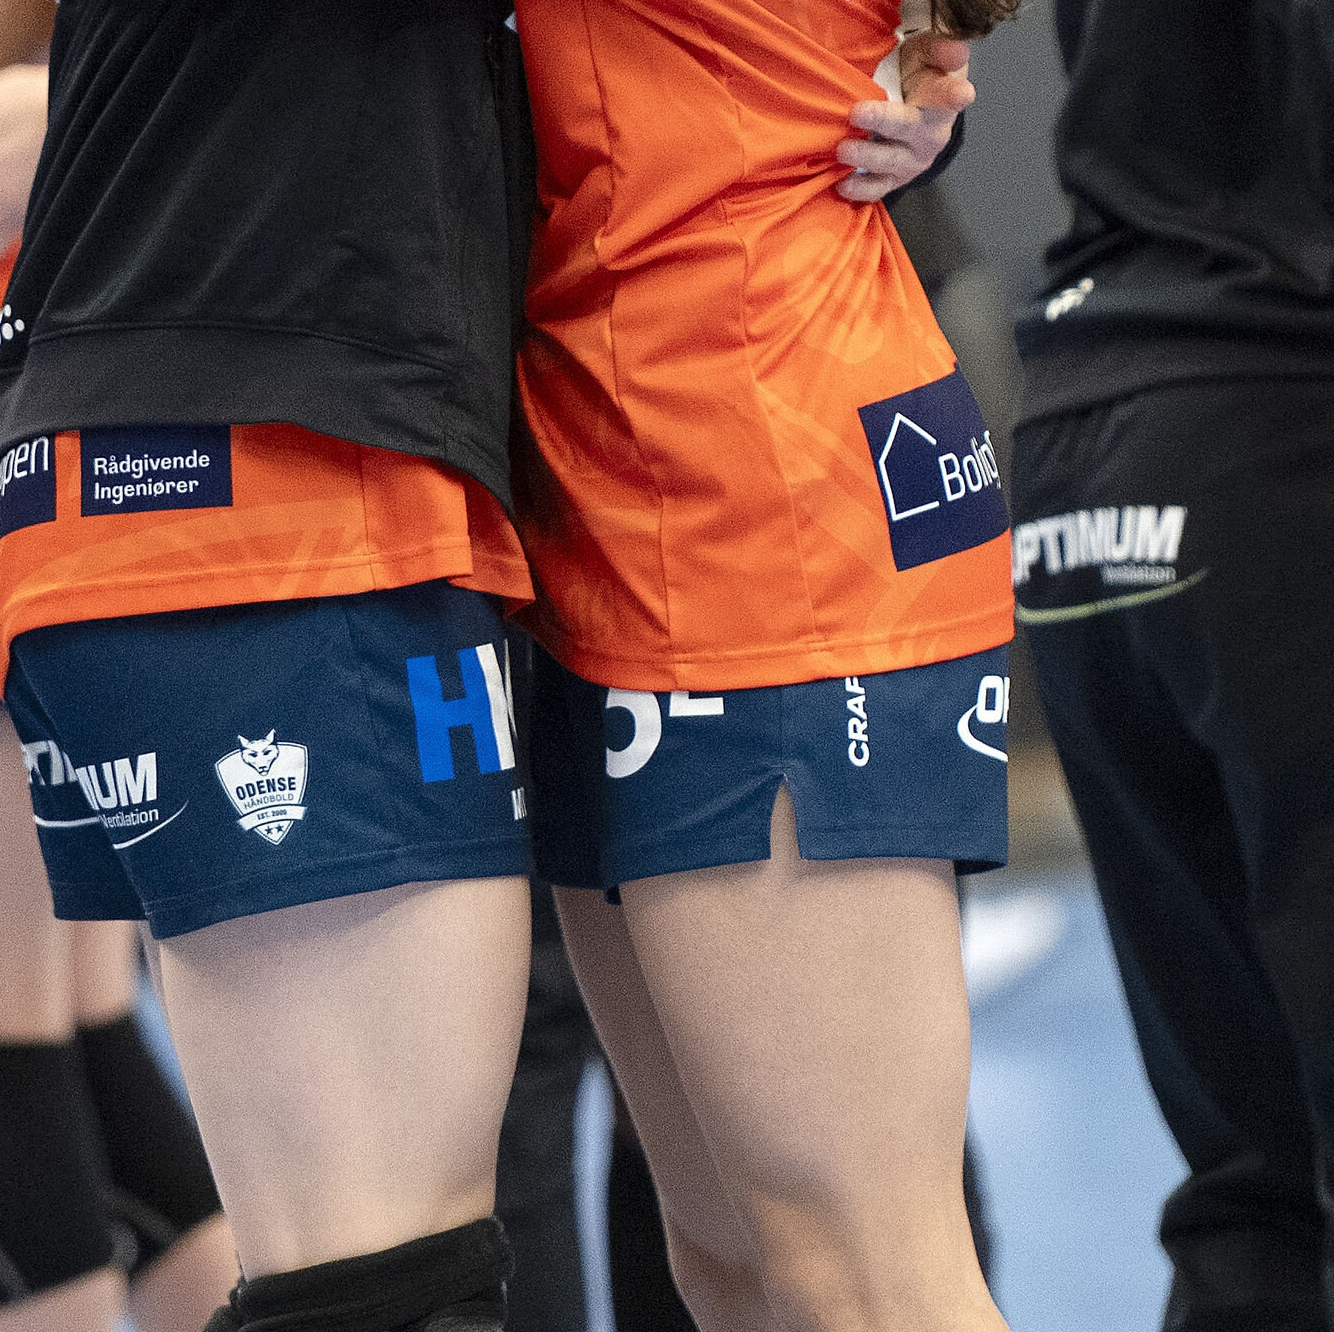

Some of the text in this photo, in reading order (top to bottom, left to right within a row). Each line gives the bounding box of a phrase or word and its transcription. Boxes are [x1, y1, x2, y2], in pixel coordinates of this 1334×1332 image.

[93, 450, 211, 479] Rådgivende
[93, 479, 199, 505] Ingeniører
[1012, 505, 1188, 588] PTIMUM
[845, 675, 869, 767] CRAF
[235, 776, 297, 801] ODENSE
[244, 793, 295, 810] HÅNDBOLD
